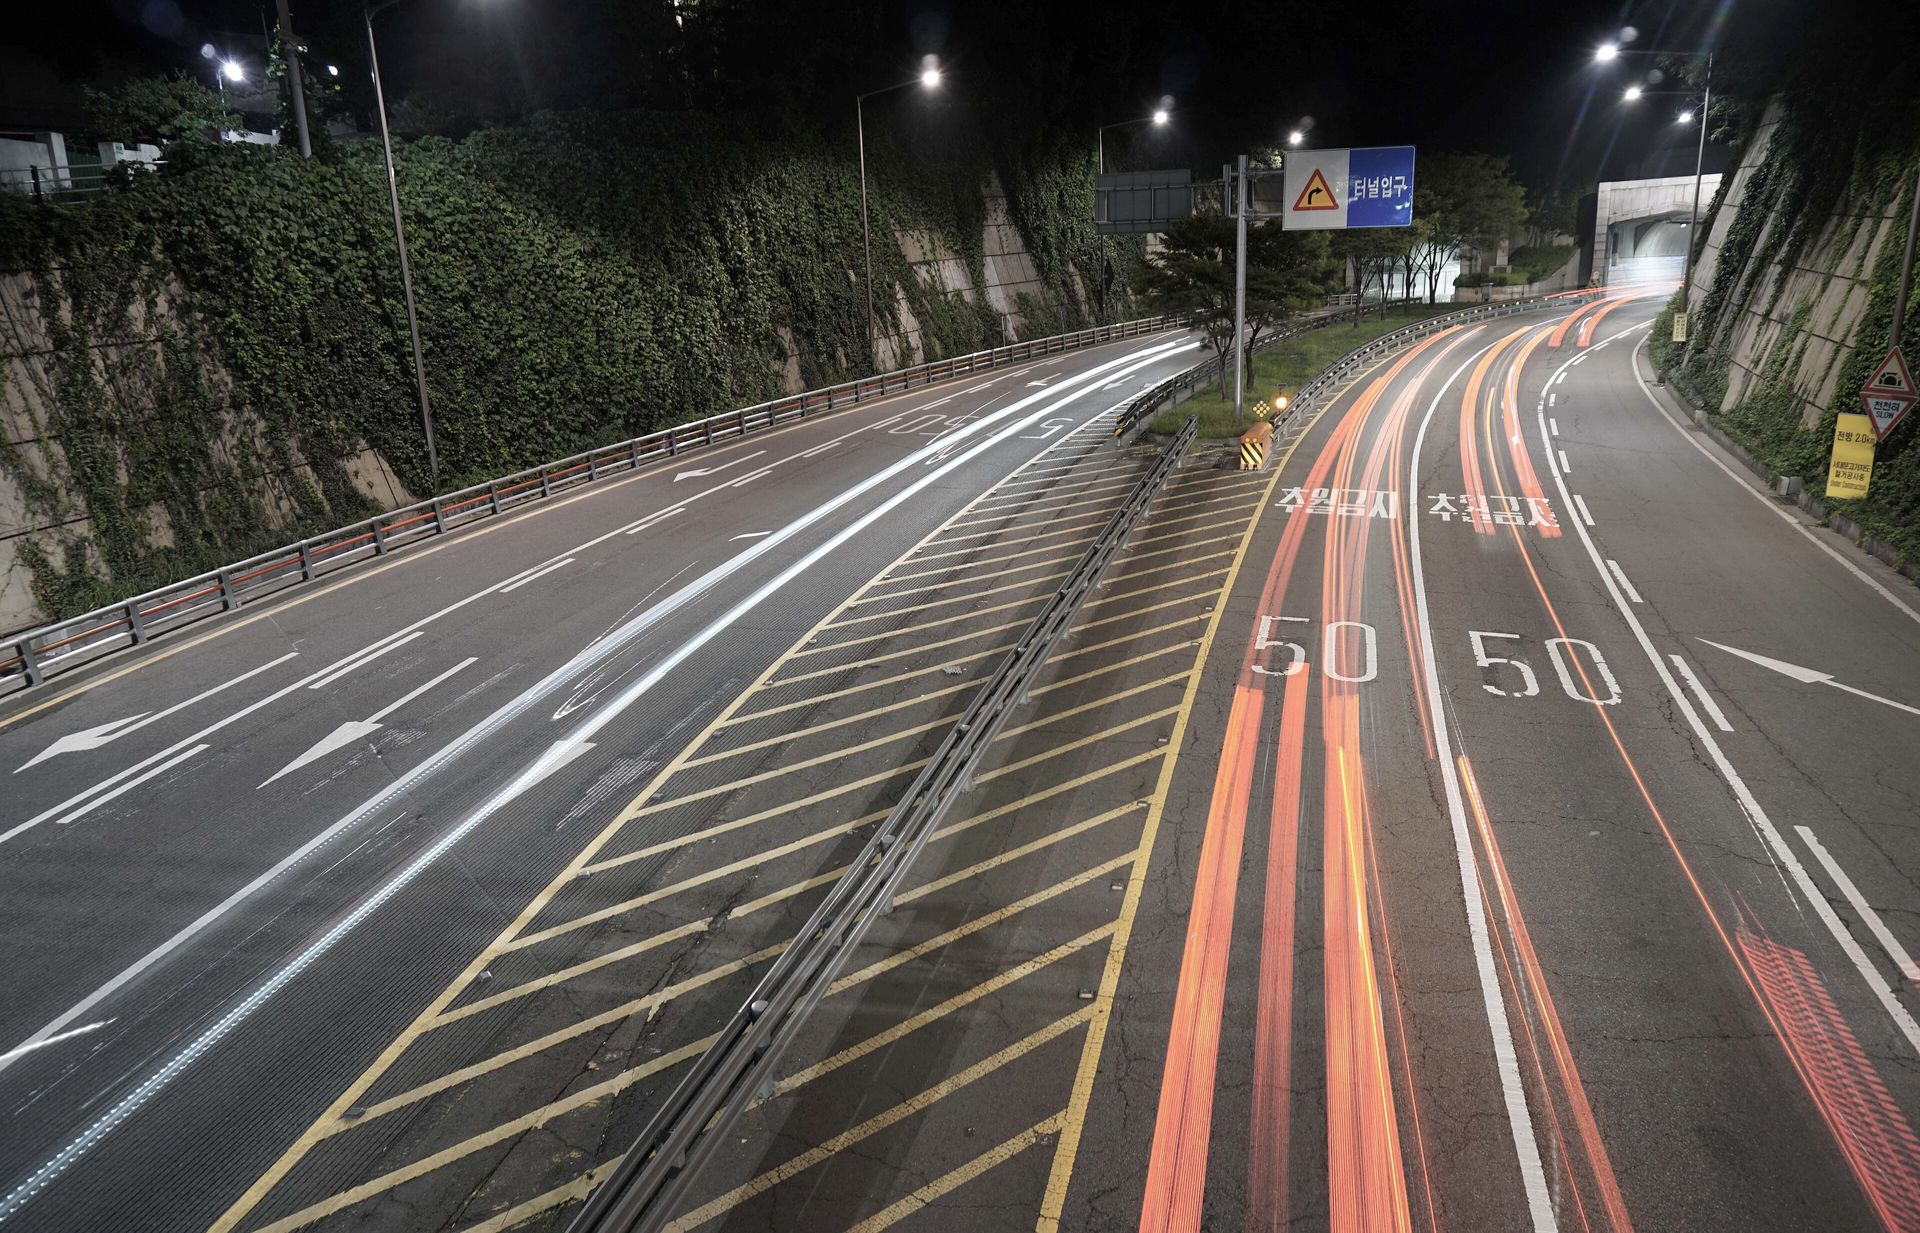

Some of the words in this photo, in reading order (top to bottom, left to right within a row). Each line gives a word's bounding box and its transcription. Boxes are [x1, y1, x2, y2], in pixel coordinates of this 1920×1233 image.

[1354, 175, 1408, 199] 터널입구
[1874, 401, 1900, 411] 천천히
[1876, 411, 1894, 419] SLOW
[1837, 431, 1853, 442] 전방
[1273, 486, 1398, 520] 추월금지
[1427, 493, 1561, 528] 추월금지
[1251, 615, 1378, 683] 50
[1468, 630, 1622, 706] 50
